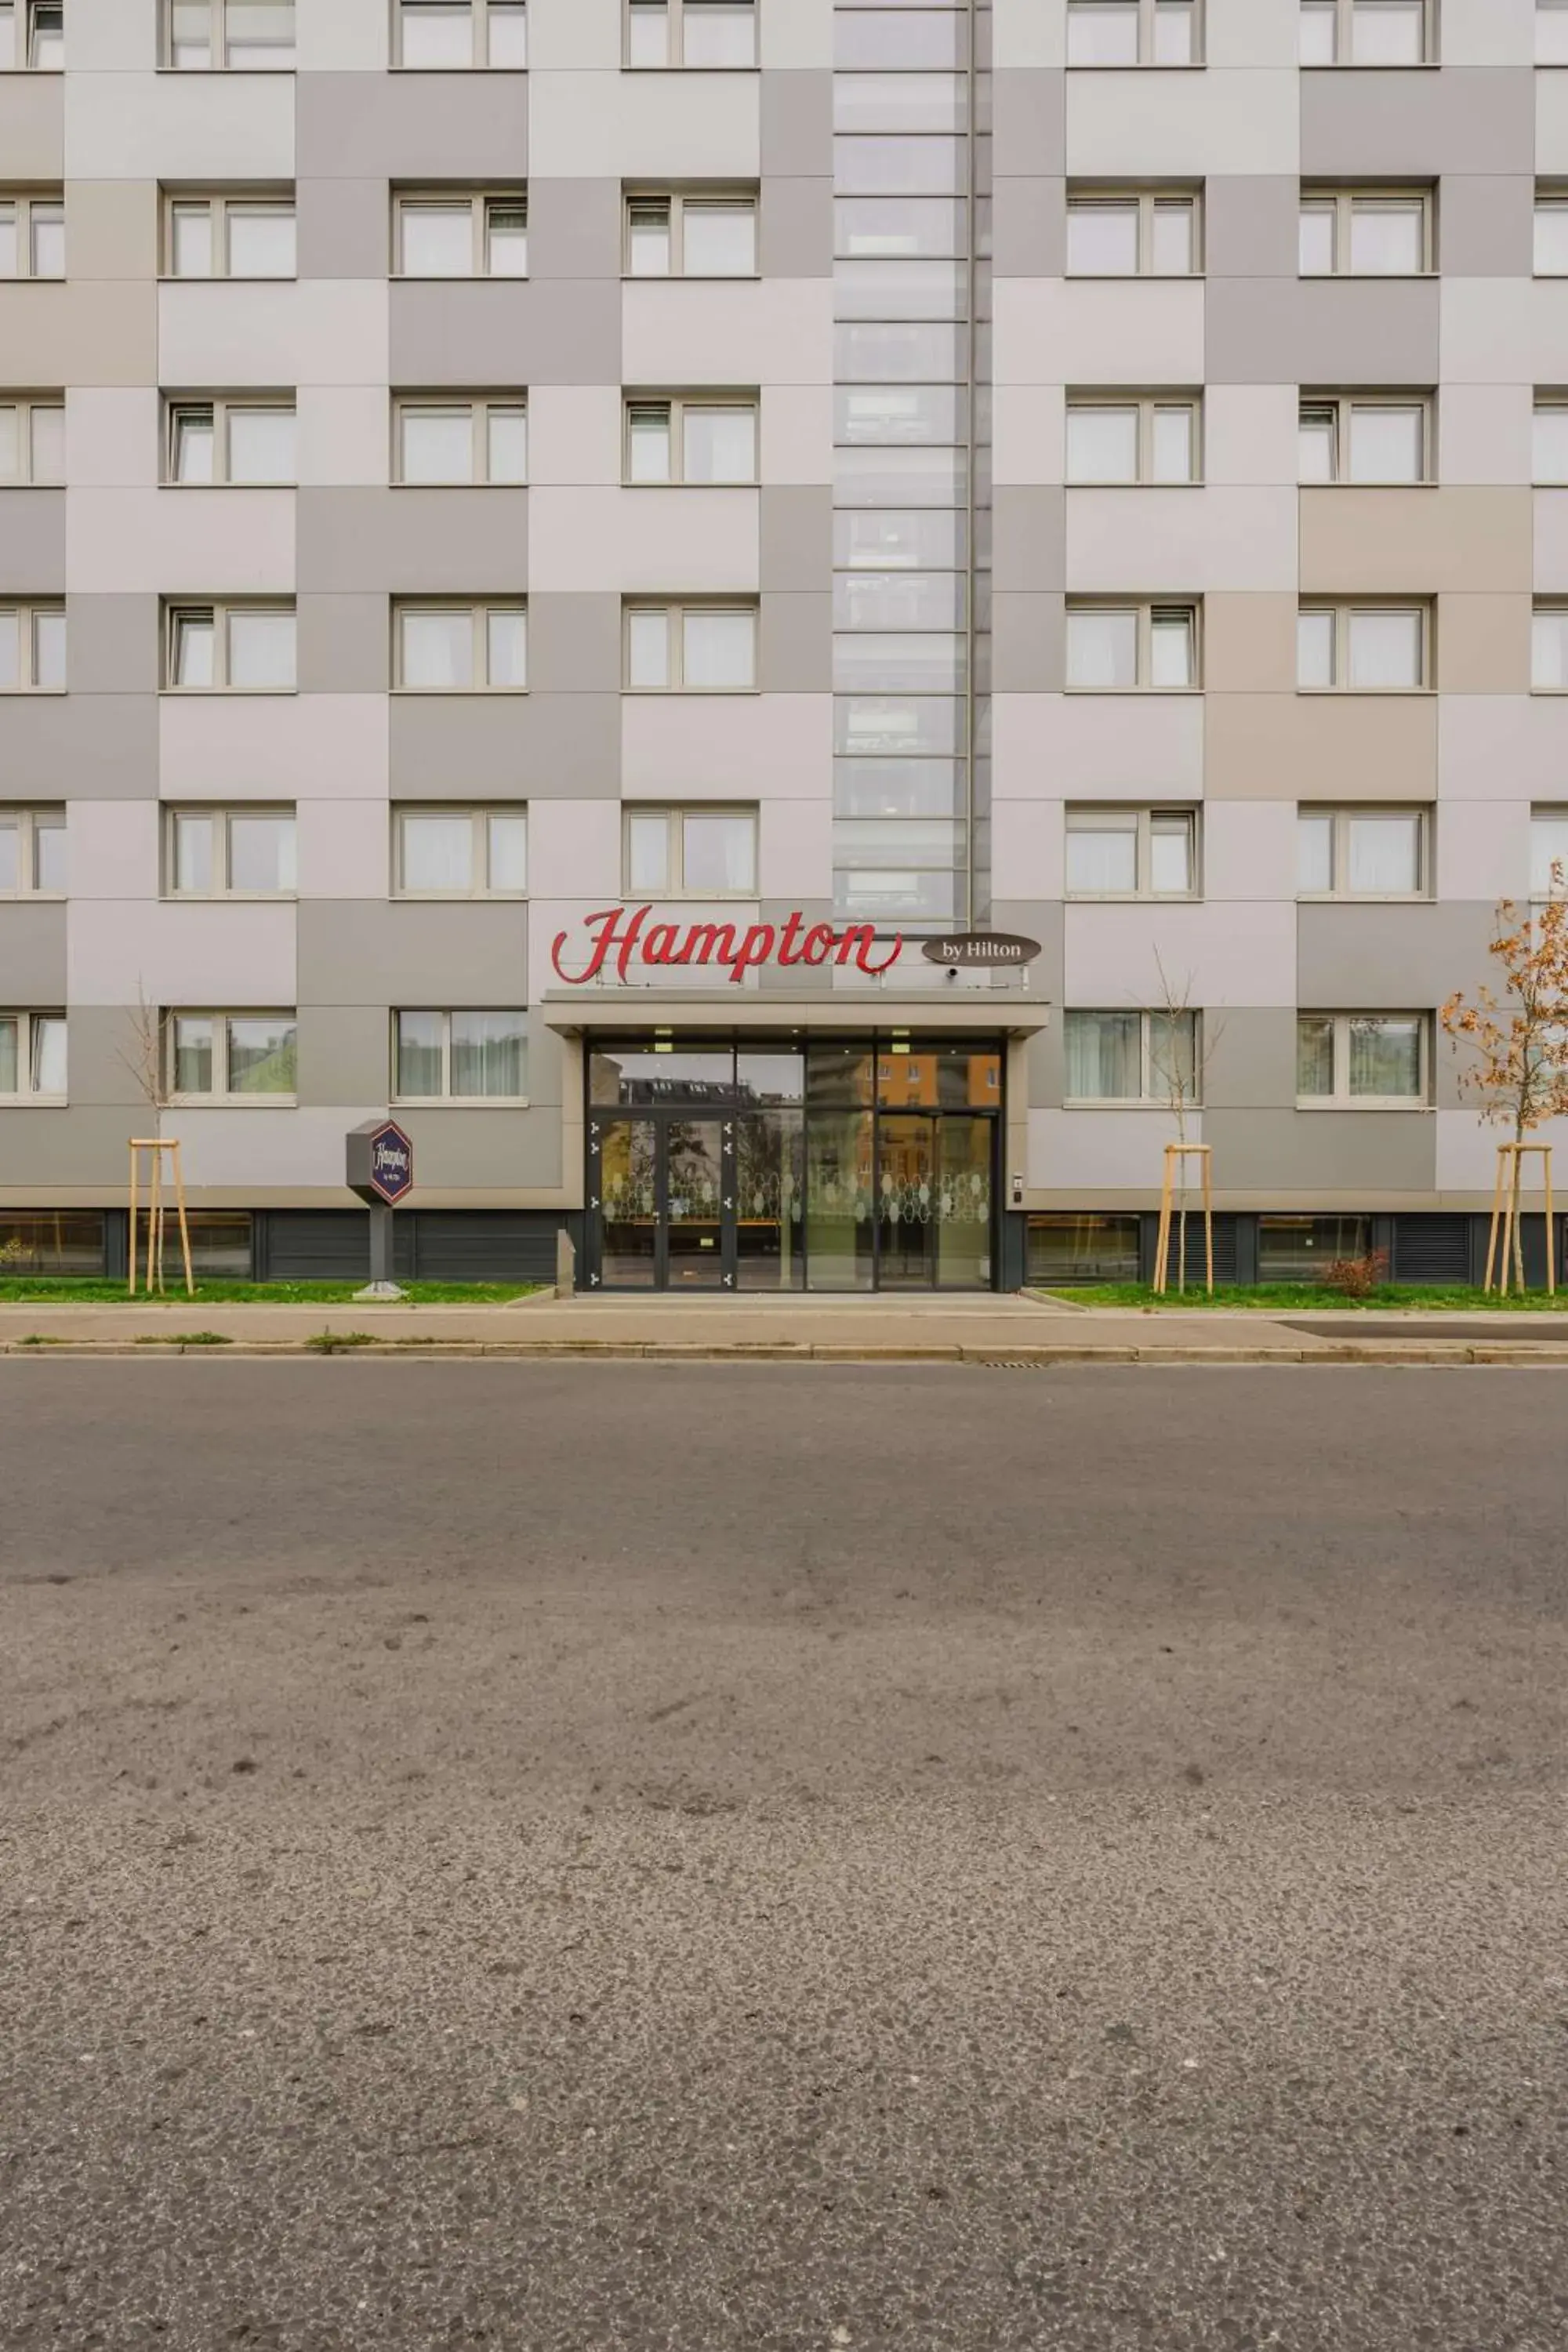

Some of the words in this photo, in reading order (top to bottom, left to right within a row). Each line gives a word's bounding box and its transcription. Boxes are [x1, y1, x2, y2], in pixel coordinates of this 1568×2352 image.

[551, 904, 902, 984] Hampton
[942, 942, 963, 960] by
[967, 942, 1022, 956] Hilton
